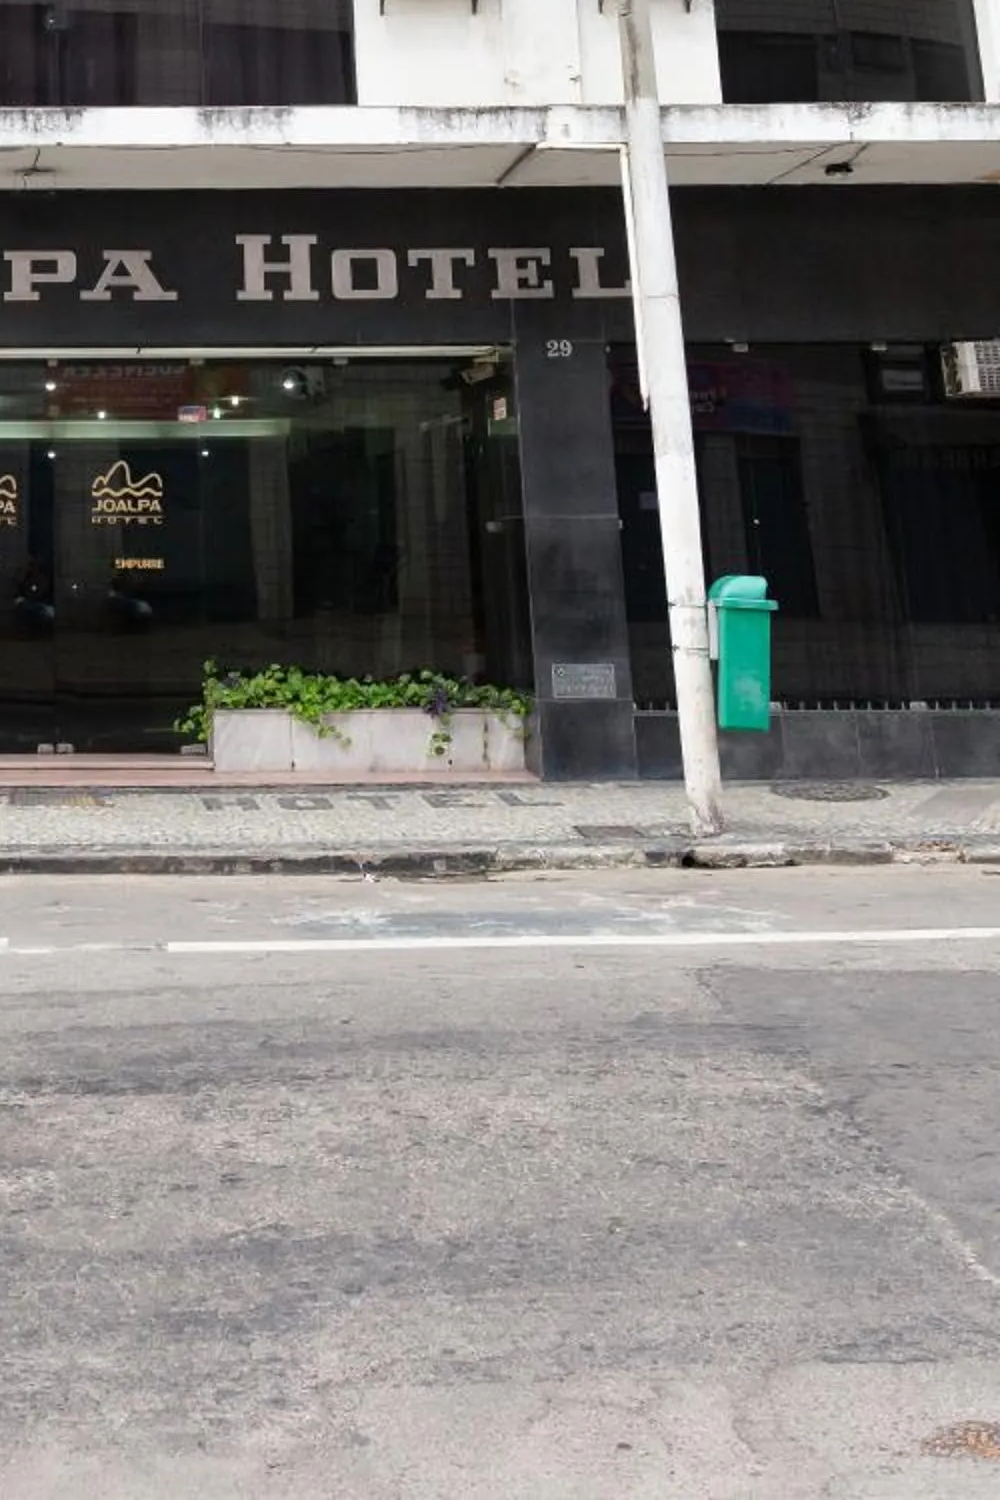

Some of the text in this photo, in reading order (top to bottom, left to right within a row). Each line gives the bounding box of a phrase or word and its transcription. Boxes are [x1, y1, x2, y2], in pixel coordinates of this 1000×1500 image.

[235, 233, 632, 301] HOTEL
[546, 340, 573, 359] 29
[91, 498, 162, 513] JOALPA
[200, 791, 564, 810] HOTEL
